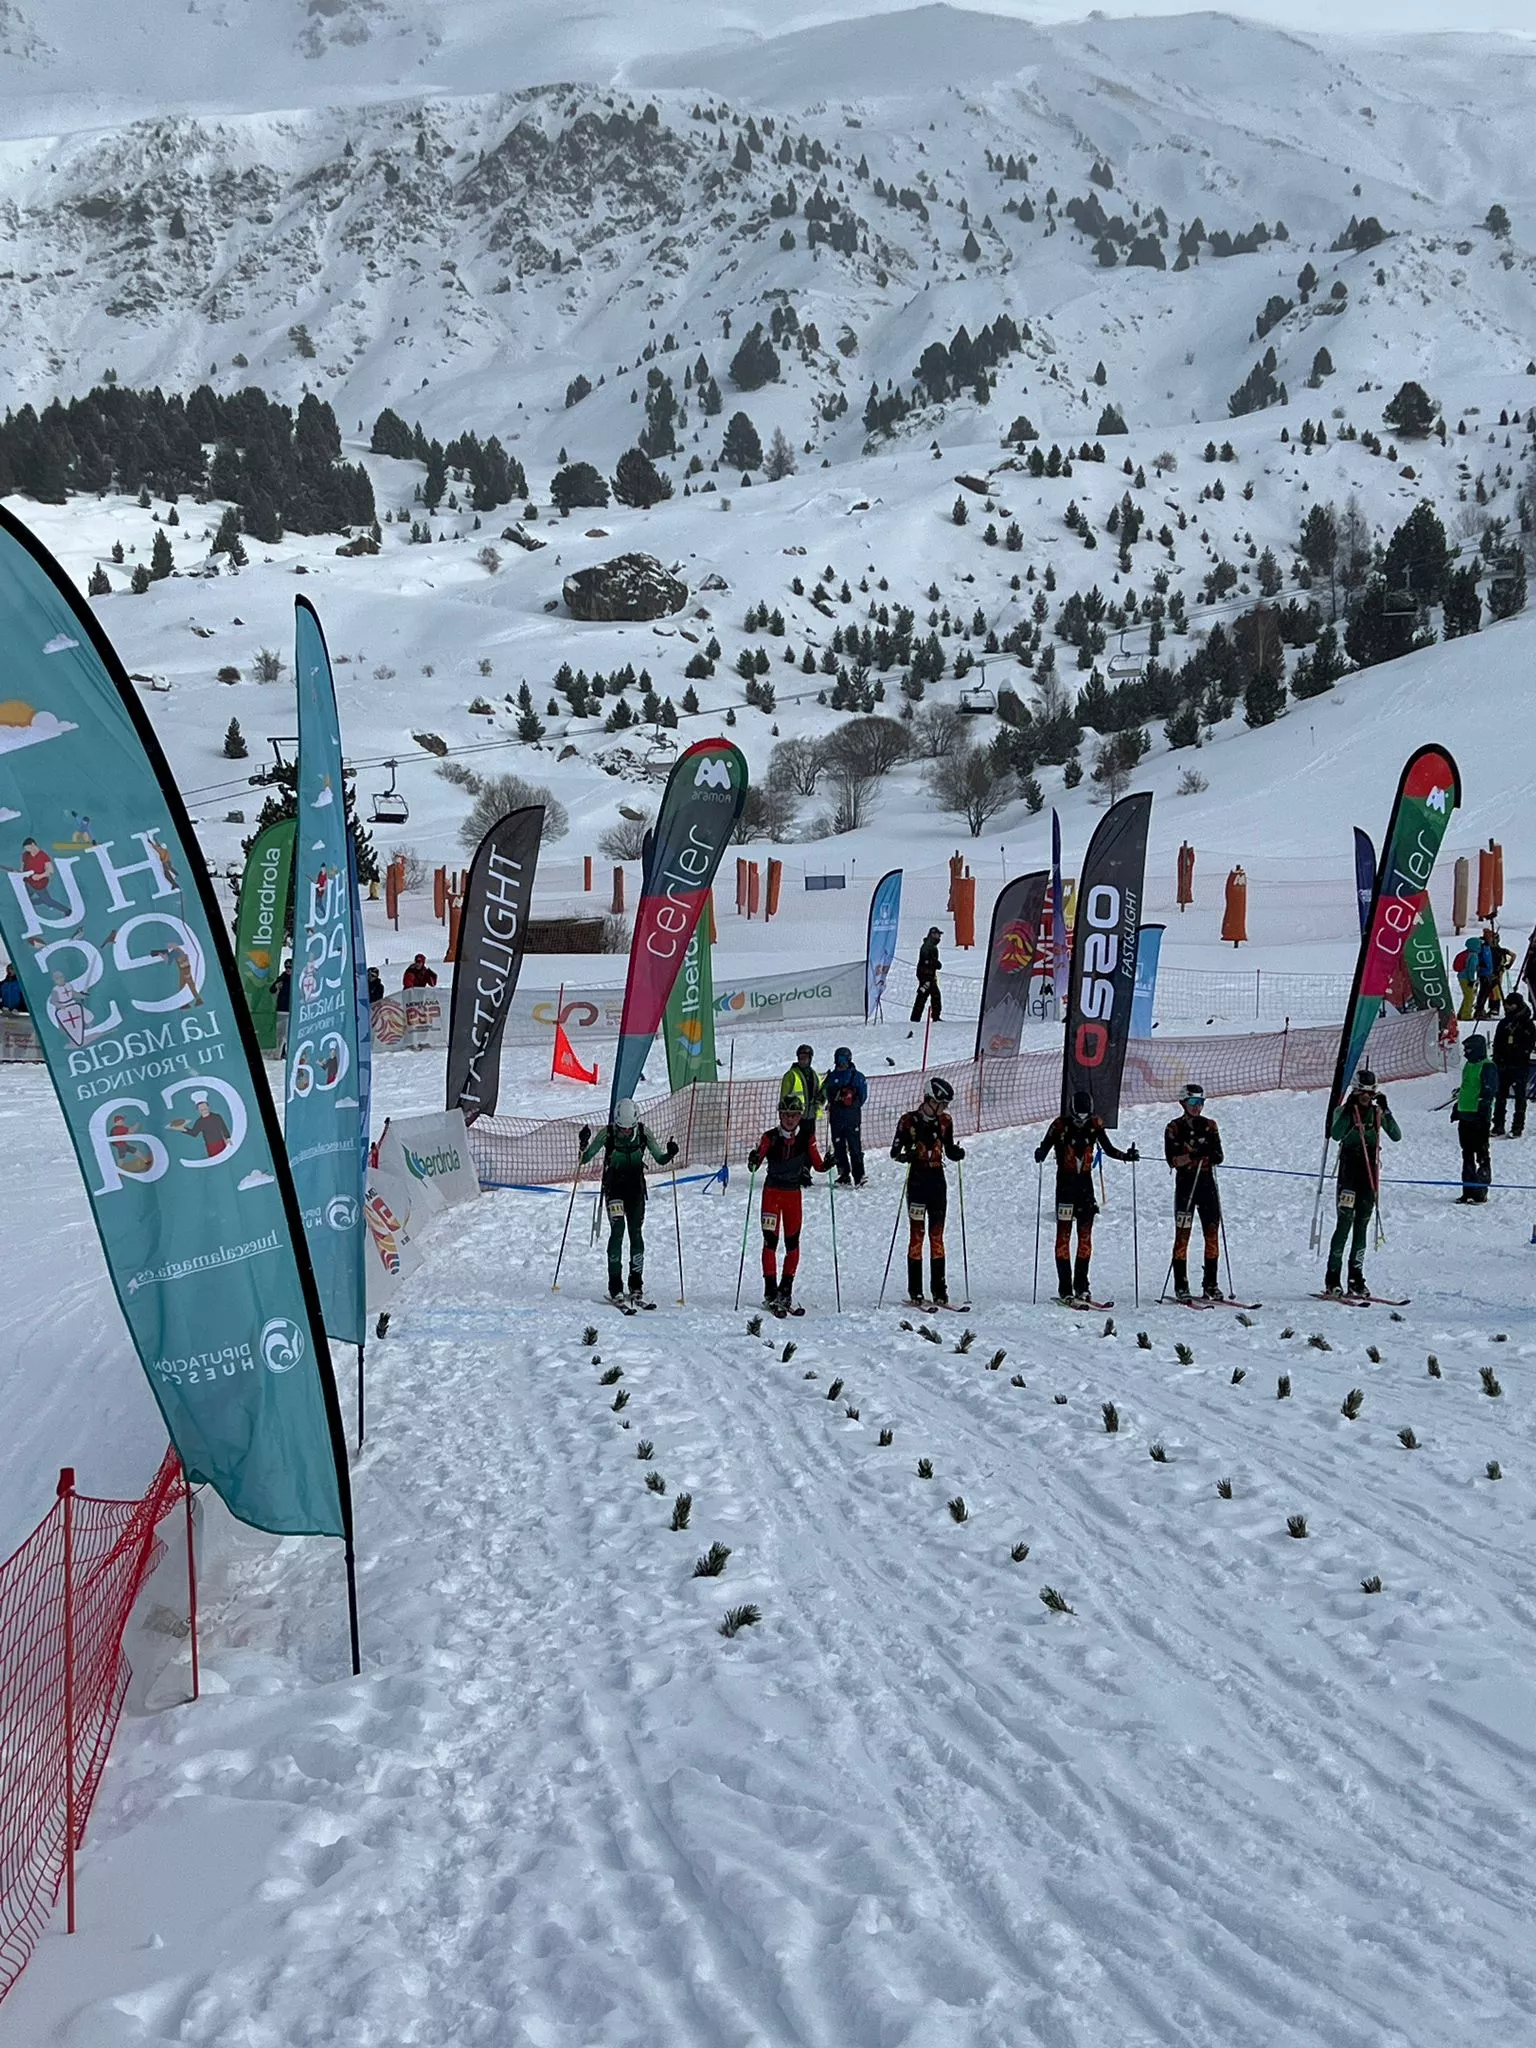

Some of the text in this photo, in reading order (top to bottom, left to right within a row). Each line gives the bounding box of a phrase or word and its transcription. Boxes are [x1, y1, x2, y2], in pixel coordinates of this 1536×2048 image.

[252, 847, 281, 945] Iberdrola
[647, 824, 714, 958] cerler
[1121, 888, 1137, 978] FAST&LIGHT
[1376, 829, 1434, 955] cerler
[751, 984, 832, 1008] Iberdrola
[1413, 938, 1446, 1010] cerler
[412, 1143, 460, 1178] berdrola
